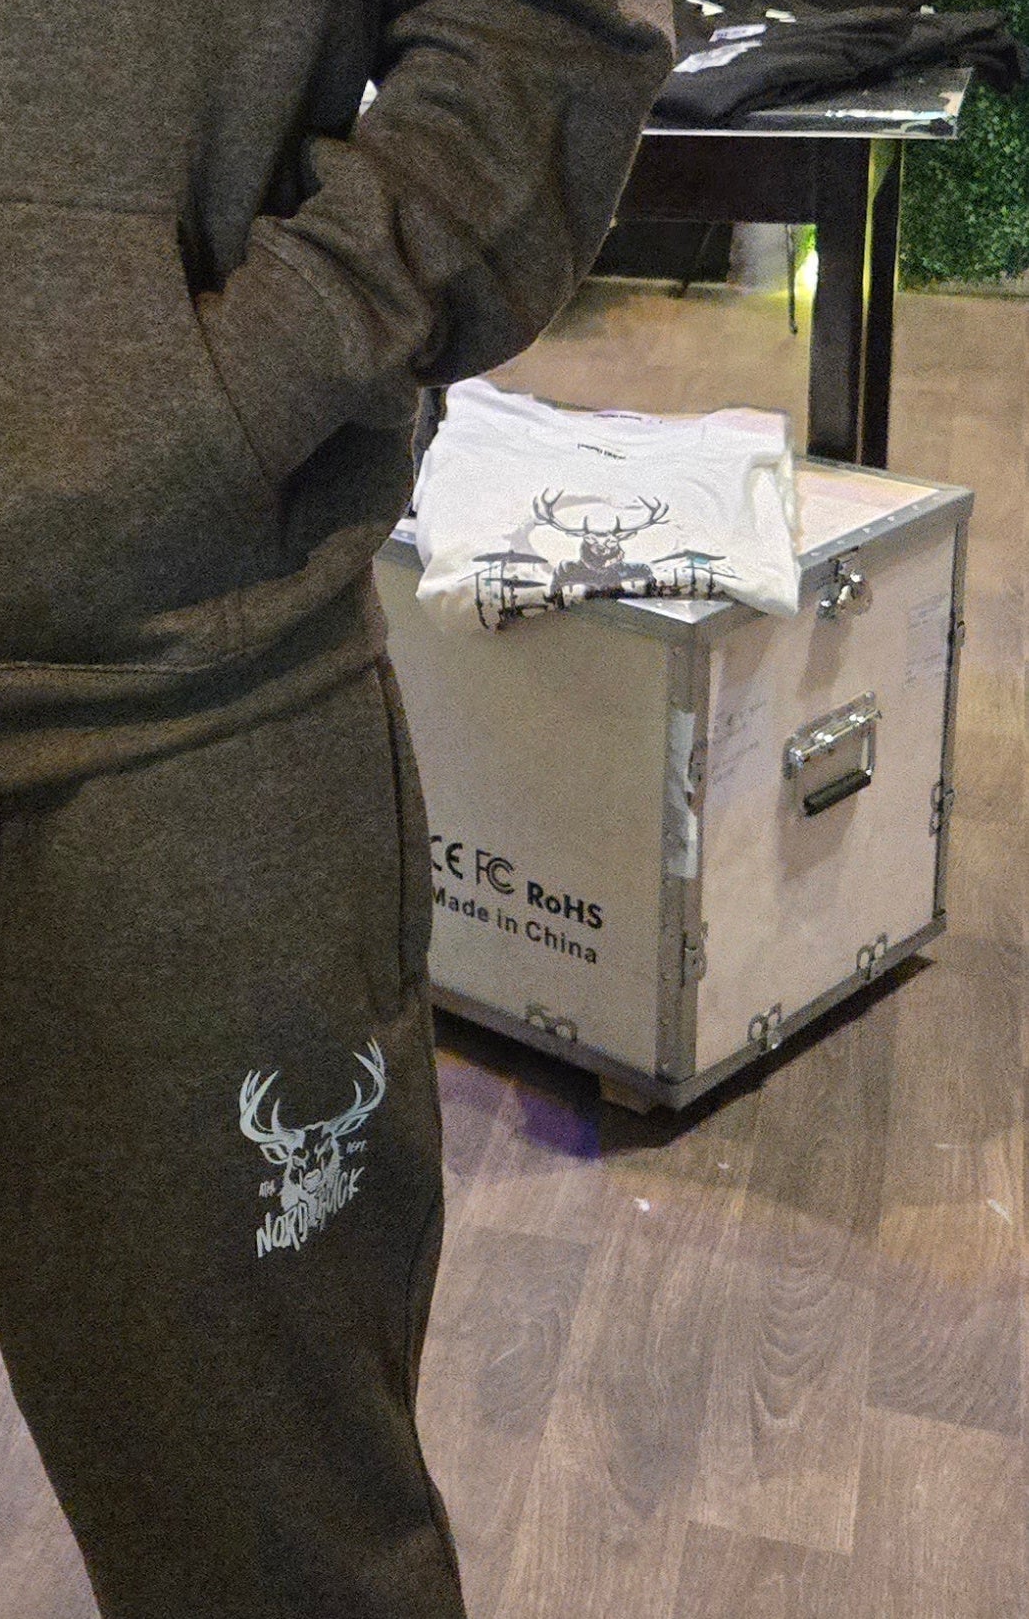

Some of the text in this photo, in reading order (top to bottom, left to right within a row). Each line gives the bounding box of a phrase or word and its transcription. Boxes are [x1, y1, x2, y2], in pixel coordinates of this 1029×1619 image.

[432, 886, 597, 965] Made in China
[527, 880, 603, 930] RoHS
[256, 1202, 308, 1258] NORD
